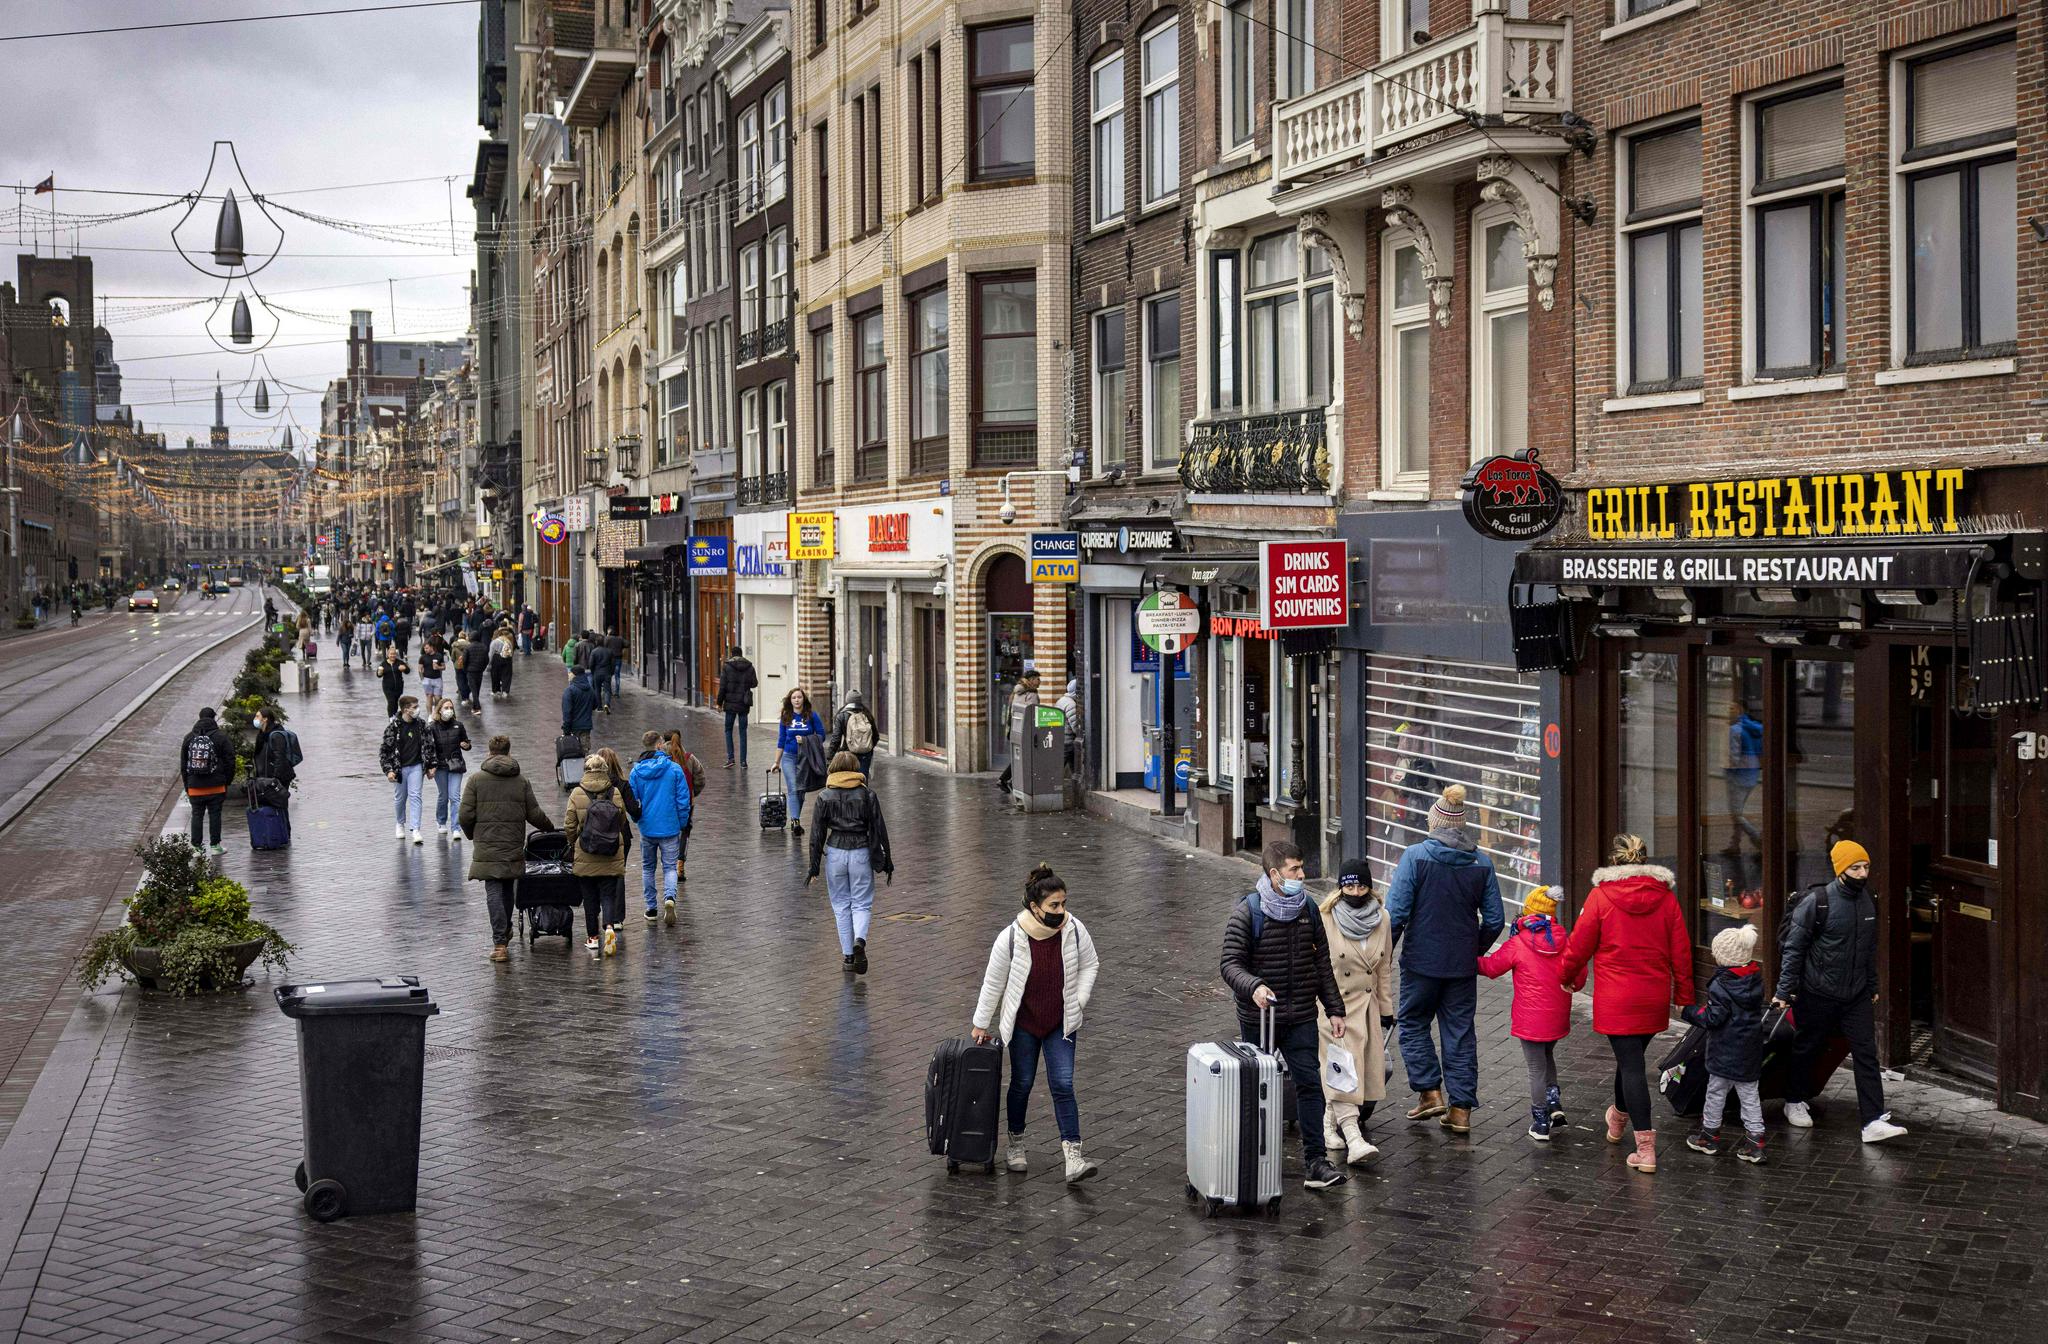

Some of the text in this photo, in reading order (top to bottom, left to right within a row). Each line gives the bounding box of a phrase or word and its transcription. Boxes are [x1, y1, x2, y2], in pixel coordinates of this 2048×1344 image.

[1487, 468, 1531, 481] Los Toros
[1587, 468, 1963, 539] GRILL RESTAURANT
[795, 516, 827, 524] MACAU
[868, 513, 908, 541] MACAU
[1491, 518, 1549, 535] Restaurant
[1509, 513, 1531, 523] Grill
[1034, 540, 1075, 551] CHANGE
[1081, 531, 1173, 549] CURRENCY EXCHANGE
[691, 548, 725, 556] SUNRO
[1035, 564, 1075, 576] ATM
[1284, 552, 1329, 571] DRINKS
[1563, 556, 1894, 581] BRASSERIE & GRILL RESTAURANT
[692, 568, 726, 576] CHANGE
[1275, 575, 1340, 594] SIM CARDS
[1274, 598, 1342, 618] SOUVENIRS
[1211, 617, 1233, 636] BON
[1547, 731, 1559, 753] 10
